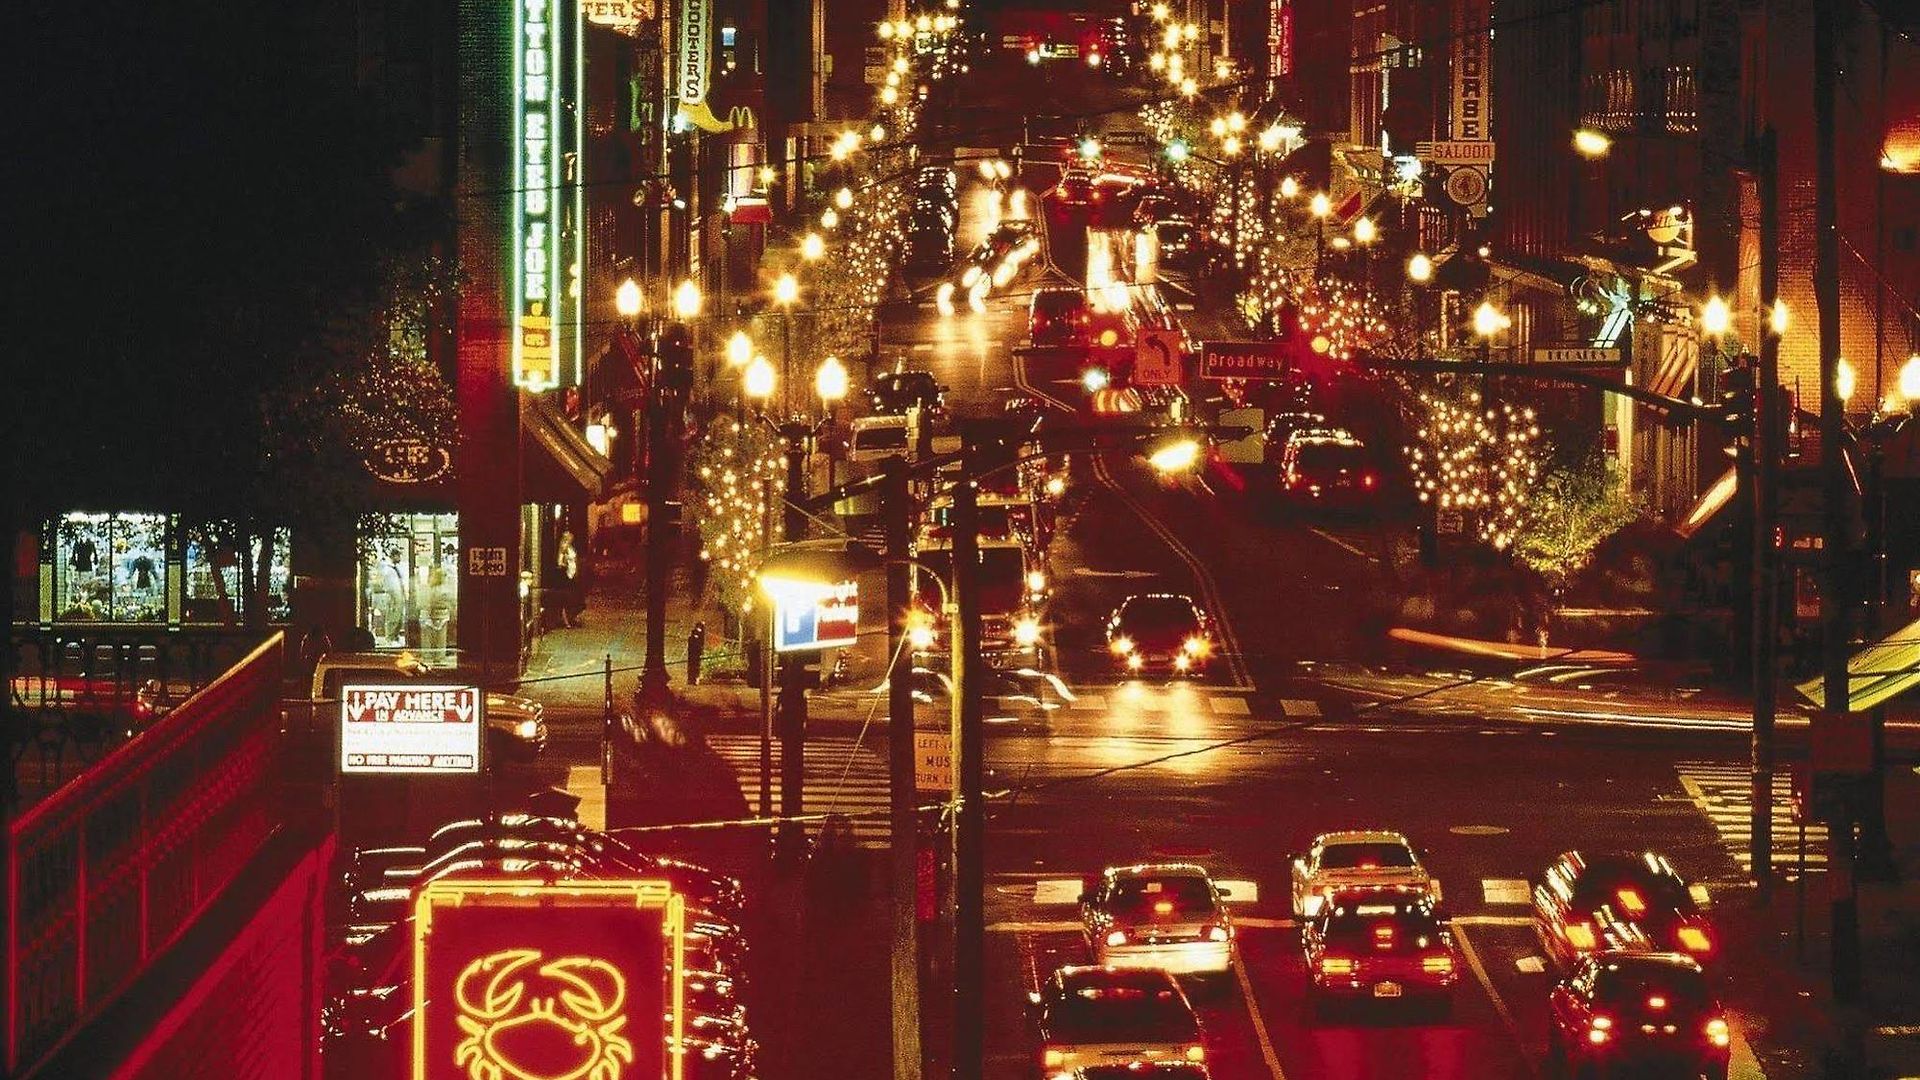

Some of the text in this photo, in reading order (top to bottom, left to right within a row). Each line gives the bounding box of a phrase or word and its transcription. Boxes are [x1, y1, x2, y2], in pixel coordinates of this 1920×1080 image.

[1435, 145, 1491, 158] SALOON
[524, 222, 548, 299] JOE
[1209, 352, 1284, 370] Broadway
[365, 691, 456, 710] PAY HERE
[375, 709, 444, 722] IN ADVANCE
[348, 754, 365, 766] NO
[926, 755, 950, 767] MUS
